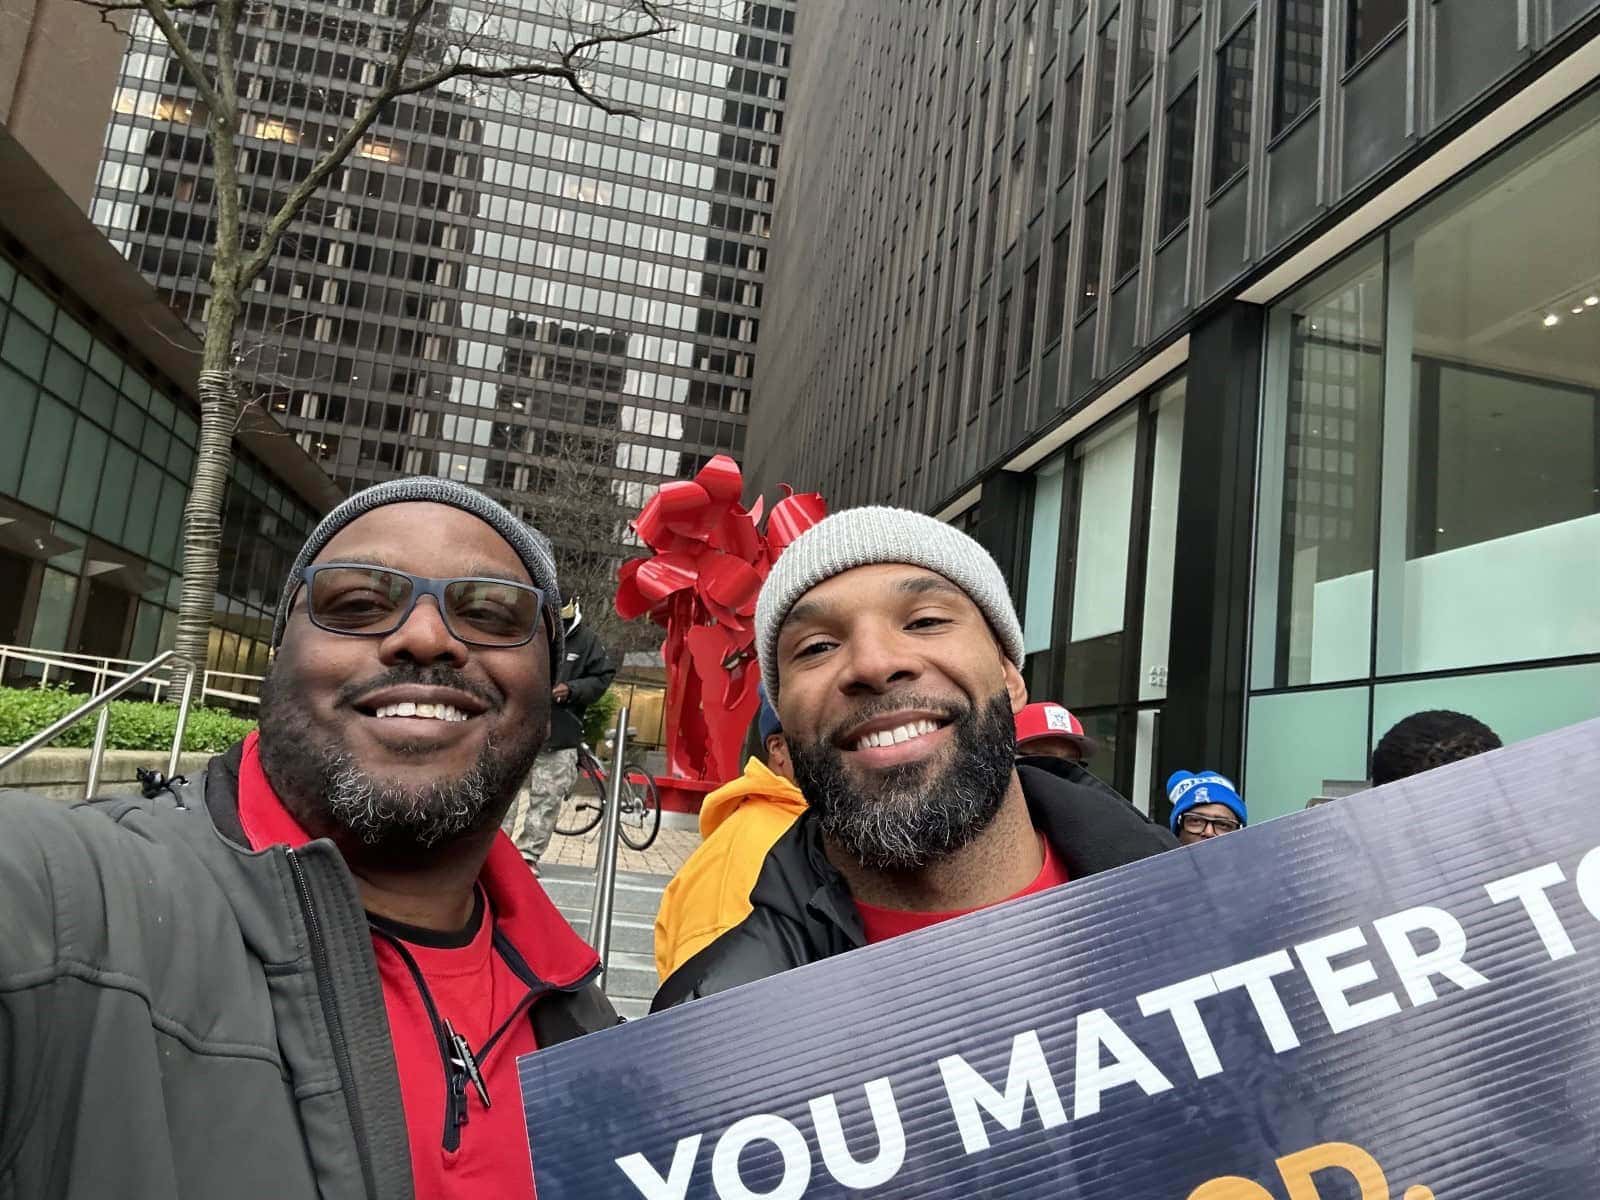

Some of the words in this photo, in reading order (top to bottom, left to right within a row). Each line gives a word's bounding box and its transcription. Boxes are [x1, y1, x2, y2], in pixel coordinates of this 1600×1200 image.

[614, 1077, 906, 1200] YOU
[937, 906, 1491, 1155] MATTER
[1483, 845, 1600, 961] T
